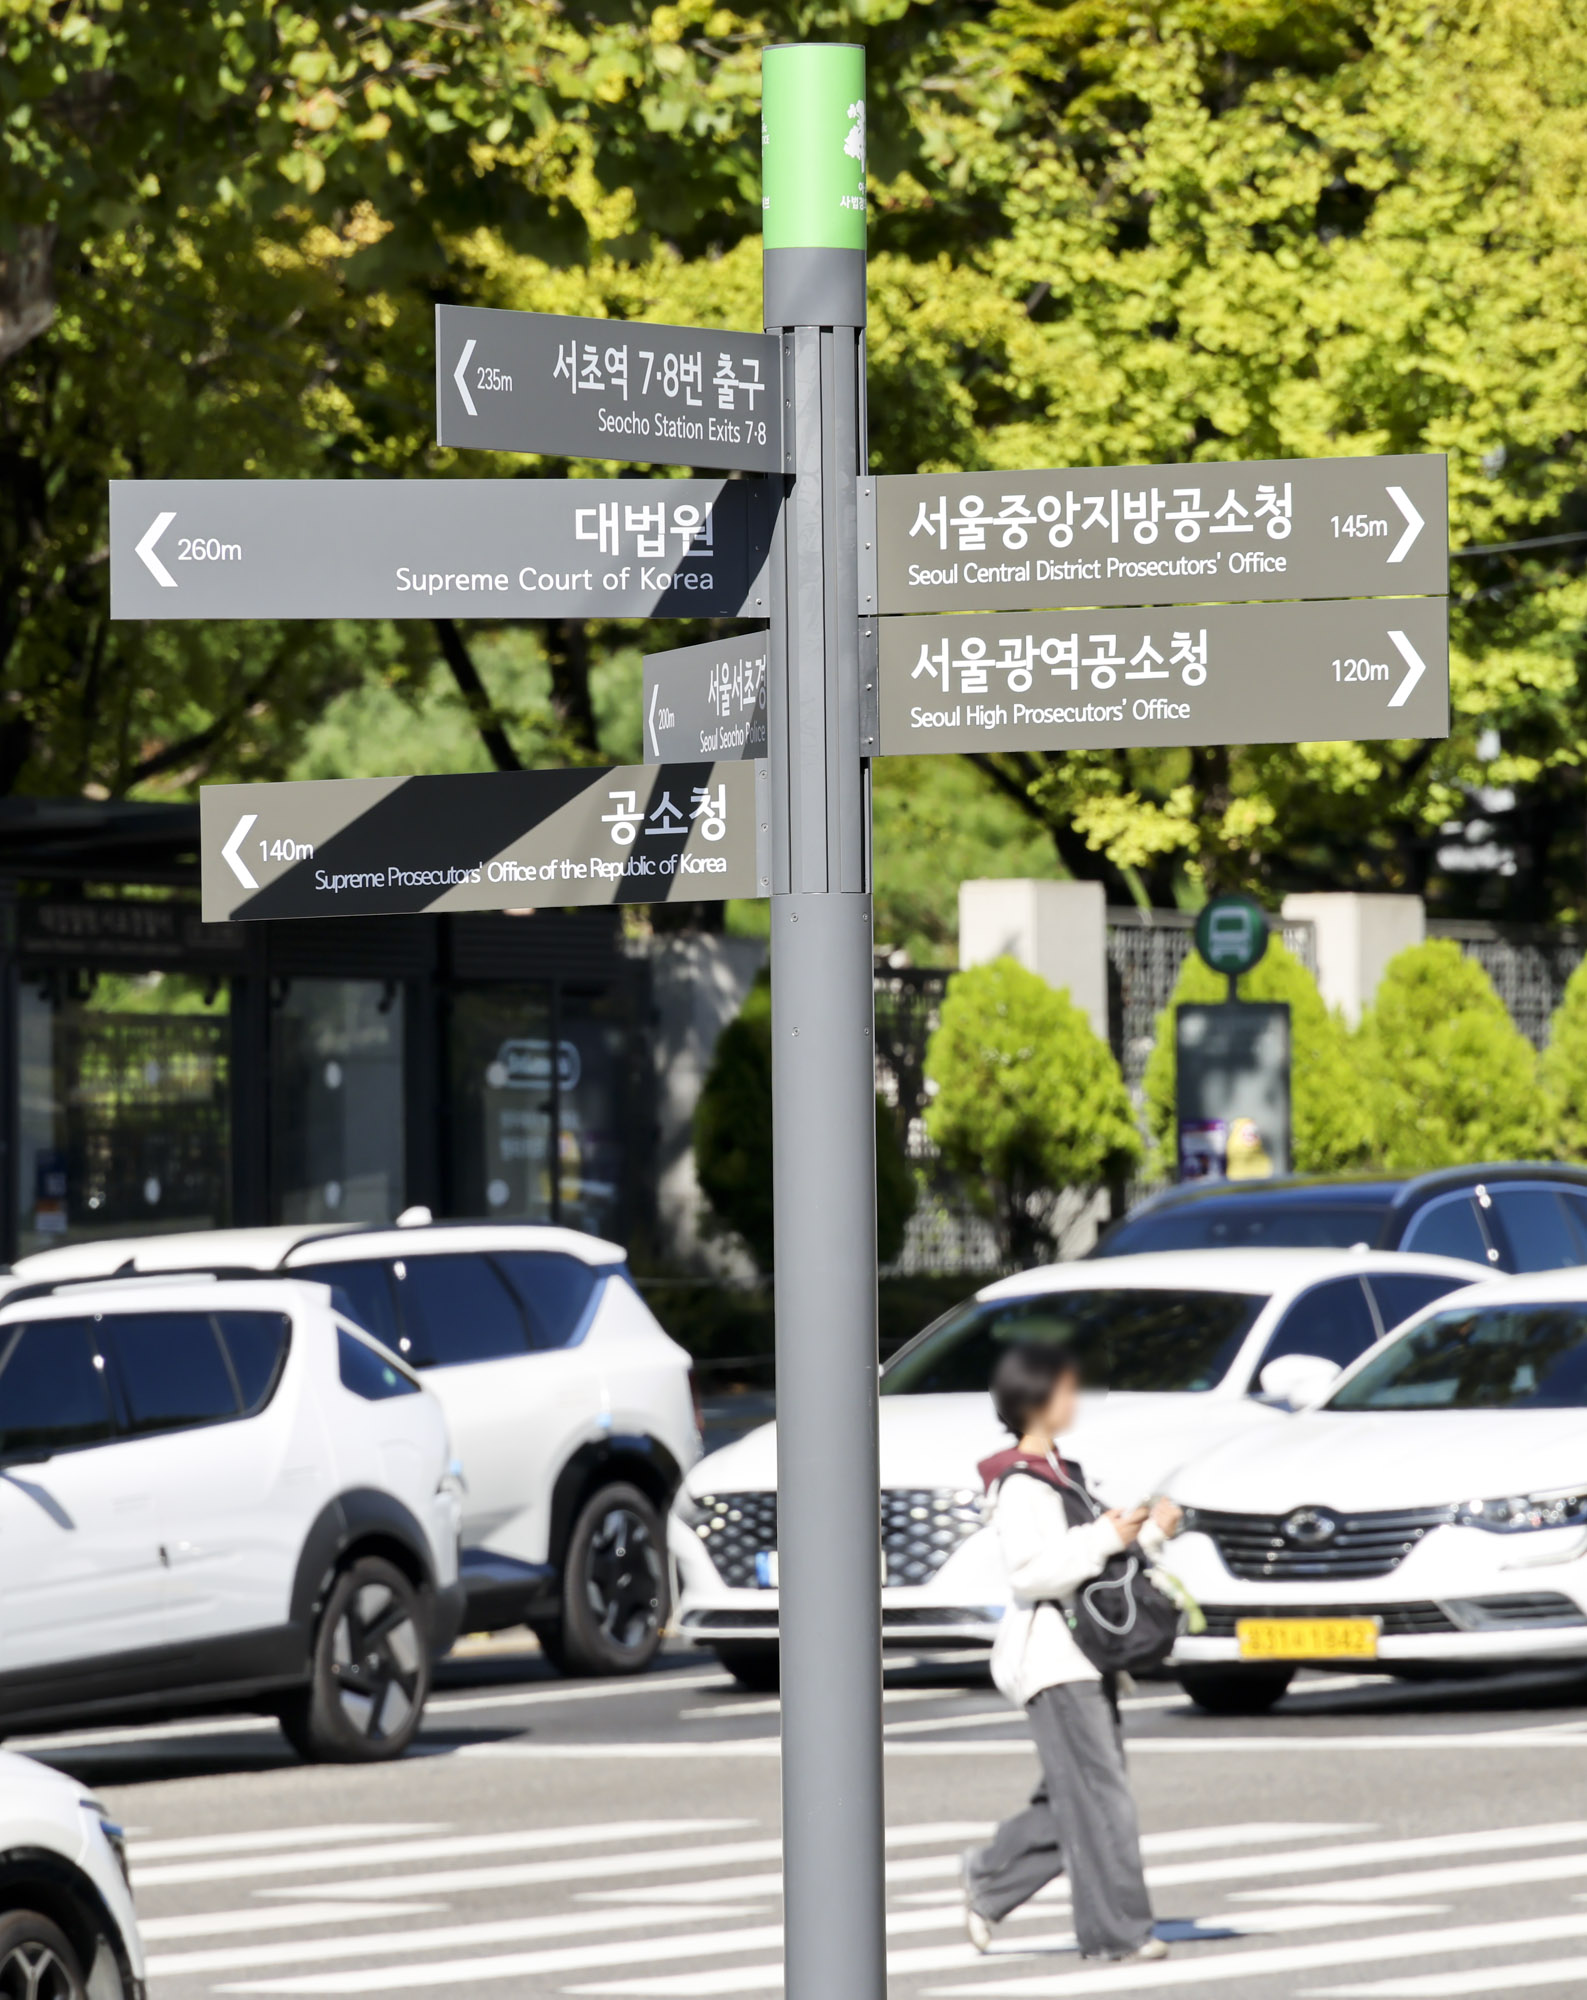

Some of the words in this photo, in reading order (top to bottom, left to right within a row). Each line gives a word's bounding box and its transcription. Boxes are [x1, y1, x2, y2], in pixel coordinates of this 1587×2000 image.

[477, 367, 512, 391] 235m
[553, 340, 627, 401] 서초역
[713, 352, 765, 411] 출구
[598, 408, 650, 435] Seocho
[655, 413, 703, 440] Station
[709, 418, 740, 443] Exits
[576, 502, 713, 557] 대법원
[909, 482, 1293, 551] 서울중앙지방공소청
[1331, 515, 1387, 538] 145m
[178, 539, 241, 560] 260m
[397, 568, 508, 595] Supreme
[519, 567, 592, 591] Court
[603, 567, 630, 590] of
[641, 567, 713, 590] Korea
[909, 563, 958, 585] Seoul
[964, 561, 1030, 583] Central
[1037, 559, 1101, 580] District
[1229, 552, 1286, 573] Office
[911, 629, 1207, 693] 서울광역공소청
[1332, 659, 1389, 681] 120m
[659, 708, 674, 730] 200m
[911, 706, 960, 728] Seoul
[967, 705, 1007, 729] High
[1133, 698, 1190, 720] Office
[700, 728, 718, 753] Seoul
[720, 724, 744, 749] Seocho
[745, 721, 766, 745] Police
[601, 784, 726, 845] 공소청
[260, 839, 313, 861] 140m
[315, 870, 385, 893] Supreme
[487, 861, 536, 882] Office
[539, 859, 558, 880] of
[560, 859, 587, 879] the
[590, 856, 656, 881] Republic
[659, 854, 678, 874] of
[681, 853, 726, 873] Korea
